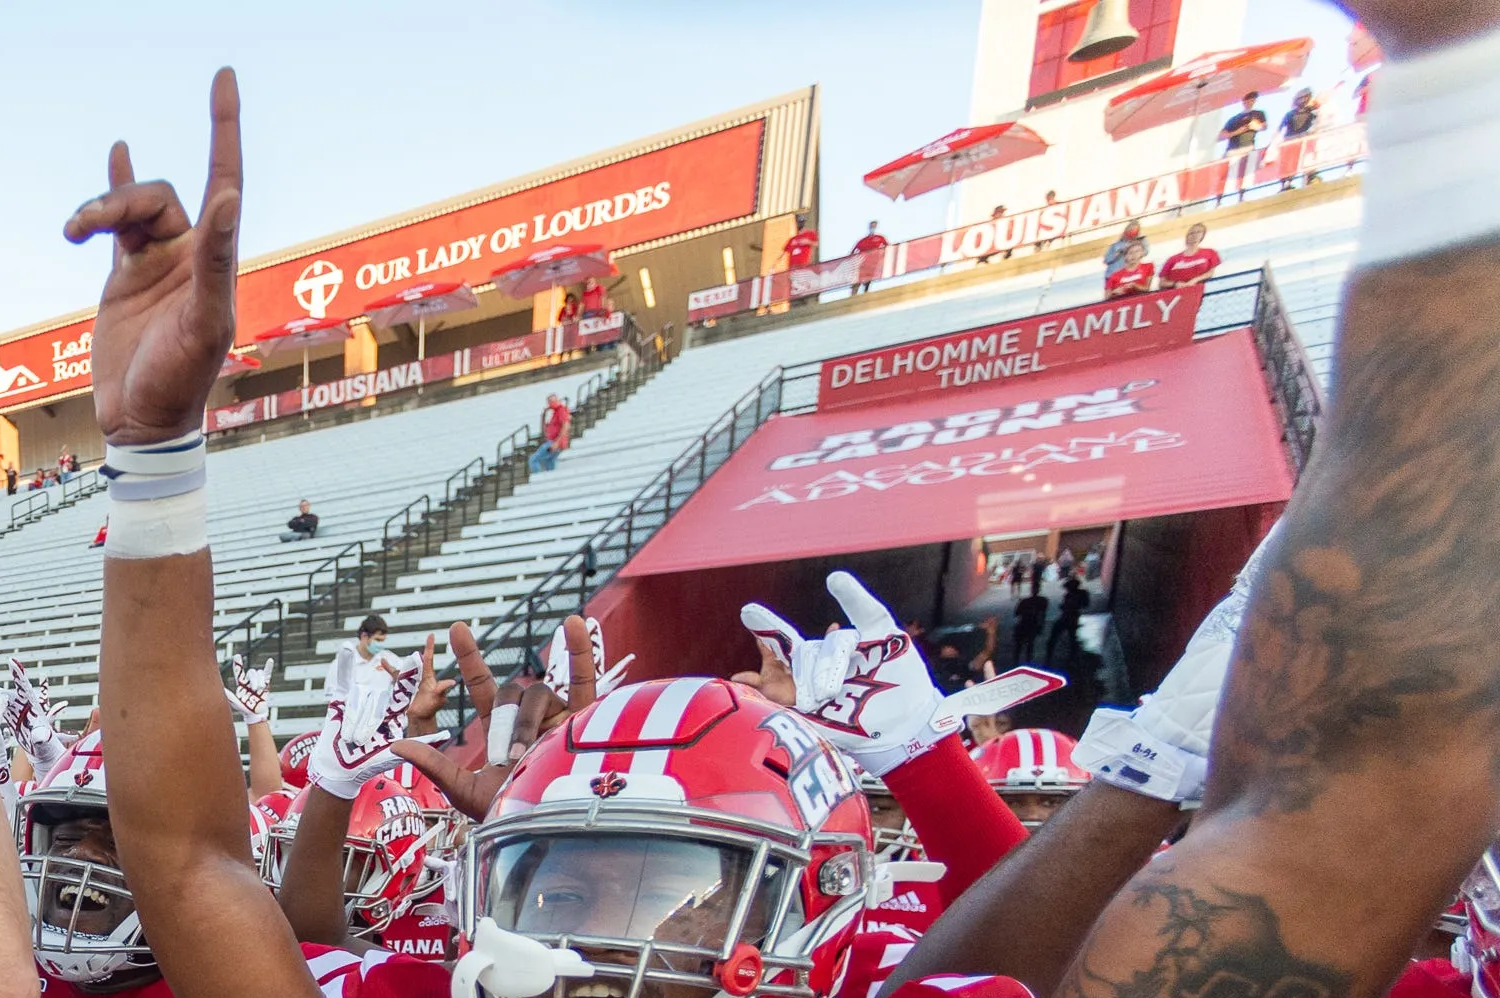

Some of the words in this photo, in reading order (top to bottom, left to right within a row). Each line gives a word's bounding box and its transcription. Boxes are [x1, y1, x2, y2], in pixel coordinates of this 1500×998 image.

[355, 256, 411, 290] OUR
[415, 233, 486, 275] LADY
[490, 223, 528, 254] OF
[532, 181, 672, 243] LOURDES
[938, 174, 1180, 263] LOUISIANA
[830, 328, 1023, 389] DELHOMME
[1035, 295, 1182, 349] FAMILY
[935, 351, 1048, 389] TUNNEL
[300, 360, 425, 411] LOUISIANA
[767, 399, 1144, 470] CAJUNS
[803, 427, 1182, 490] ACADIANA
[731, 437, 1189, 511] ADVOCATE
[961, 679, 1035, 708] ADIZERO
[906, 740, 925, 755] 2XL
